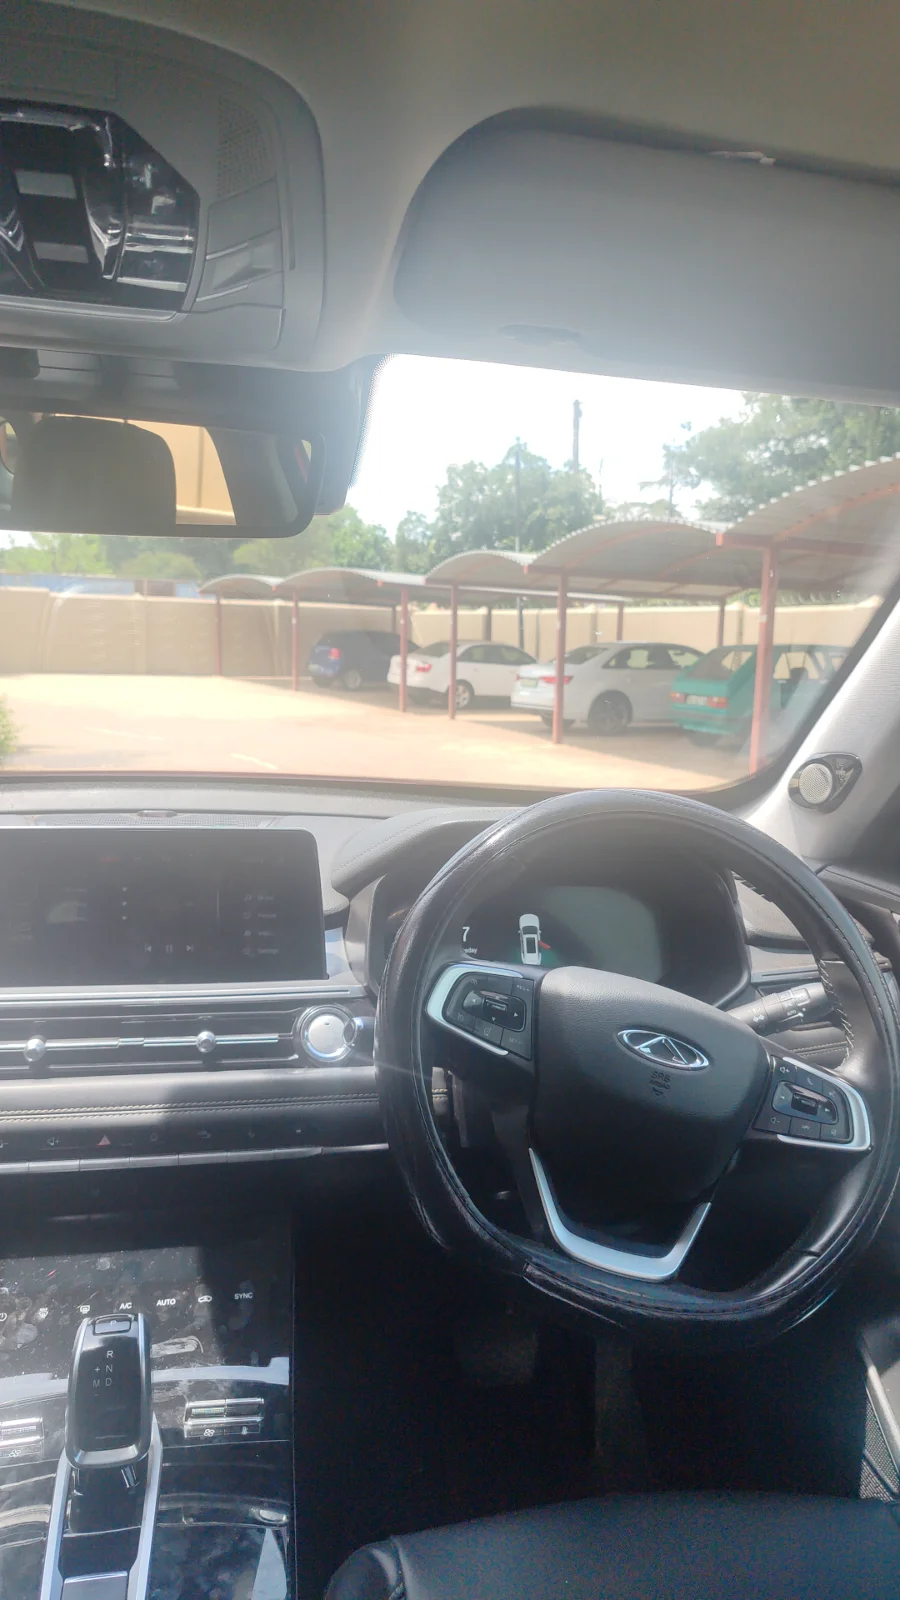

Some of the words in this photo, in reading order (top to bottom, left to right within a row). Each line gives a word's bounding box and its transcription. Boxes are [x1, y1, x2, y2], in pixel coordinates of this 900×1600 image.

[234, 1292, 254, 1300] SYNC
[119, 1302, 133, 1310] A/C
[156, 1298, 176, 1306] AUTO
[106, 1350, 114, 1359] R
[105, 1364, 113, 1373] N
[92, 1379, 100, 1388] M
[105, 1377, 113, 1387] D
